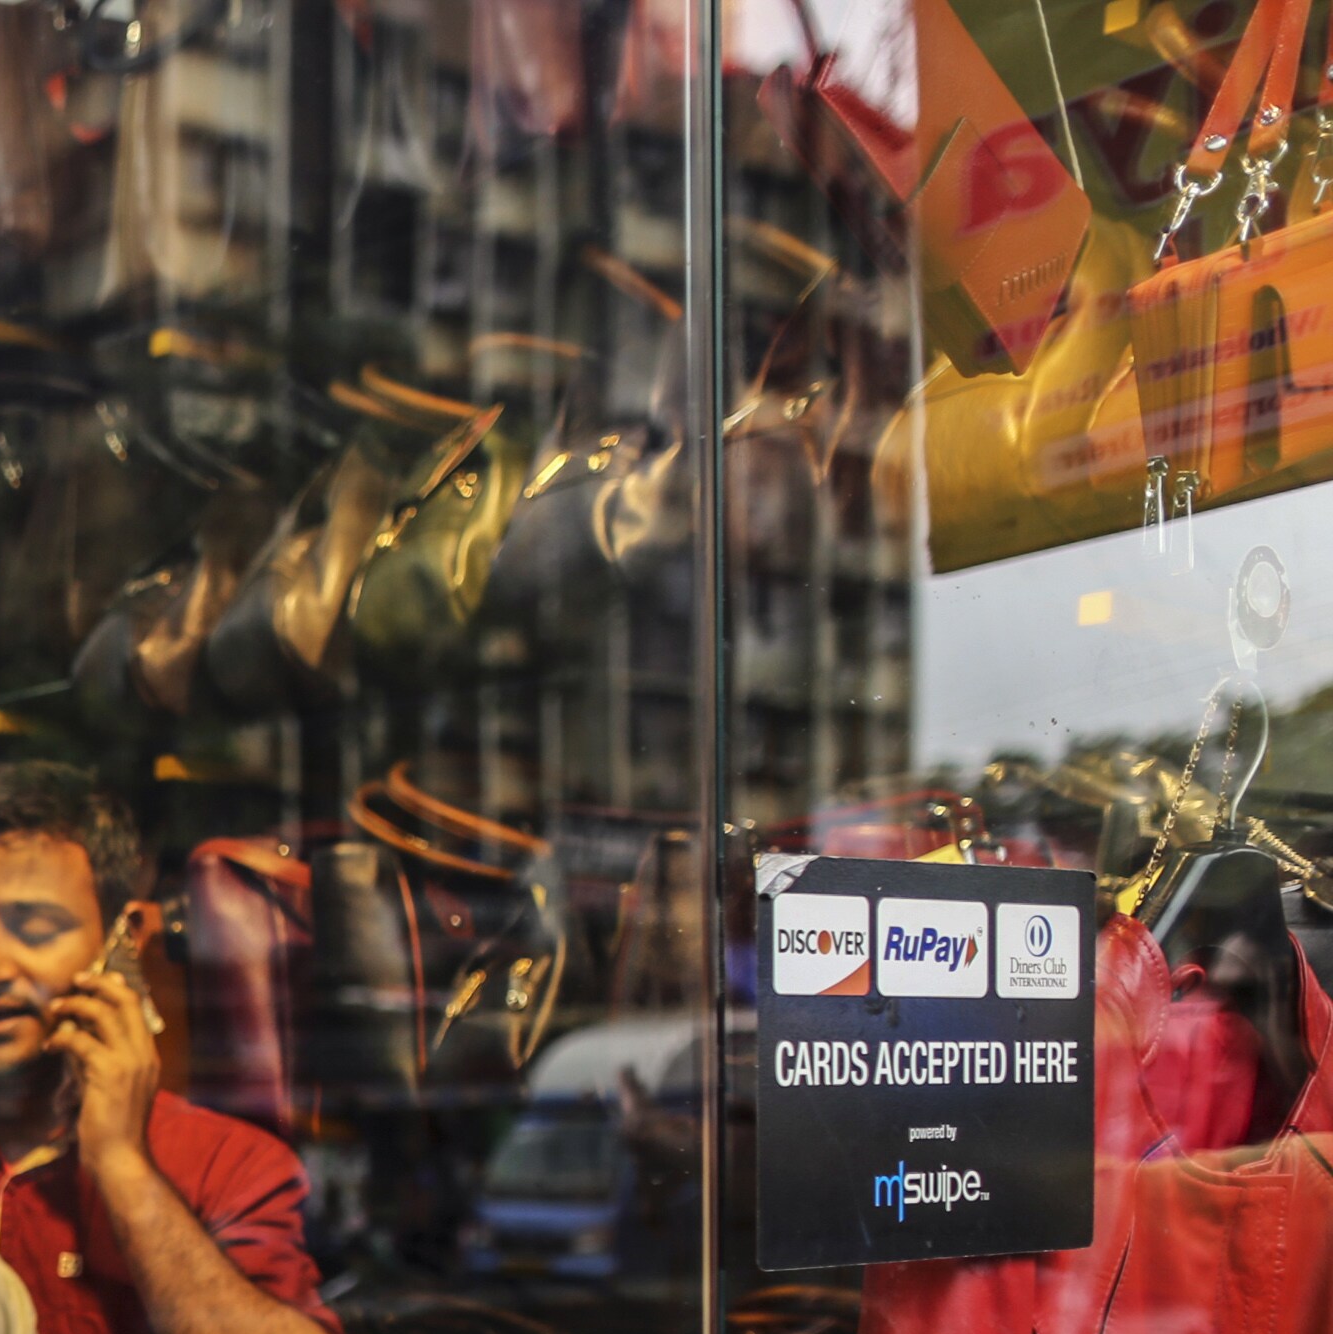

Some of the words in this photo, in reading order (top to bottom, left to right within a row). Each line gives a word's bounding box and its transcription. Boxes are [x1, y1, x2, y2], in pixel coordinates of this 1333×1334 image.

[778, 929, 864, 955] DISCOVER
[884, 926, 967, 972] RuPay
[1010, 957, 1041, 974] Diners
[1044, 957, 1067, 975] Club
[1010, 977, 1067, 987] INTERNATIONAL
[775, 1040, 869, 1087] CARDS
[874, 1040, 1007, 1085] ACCEPTED
[1014, 1041, 1078, 1083] HERE
[908, 1125, 945, 1142] powered
[946, 1125, 957, 1141] by
